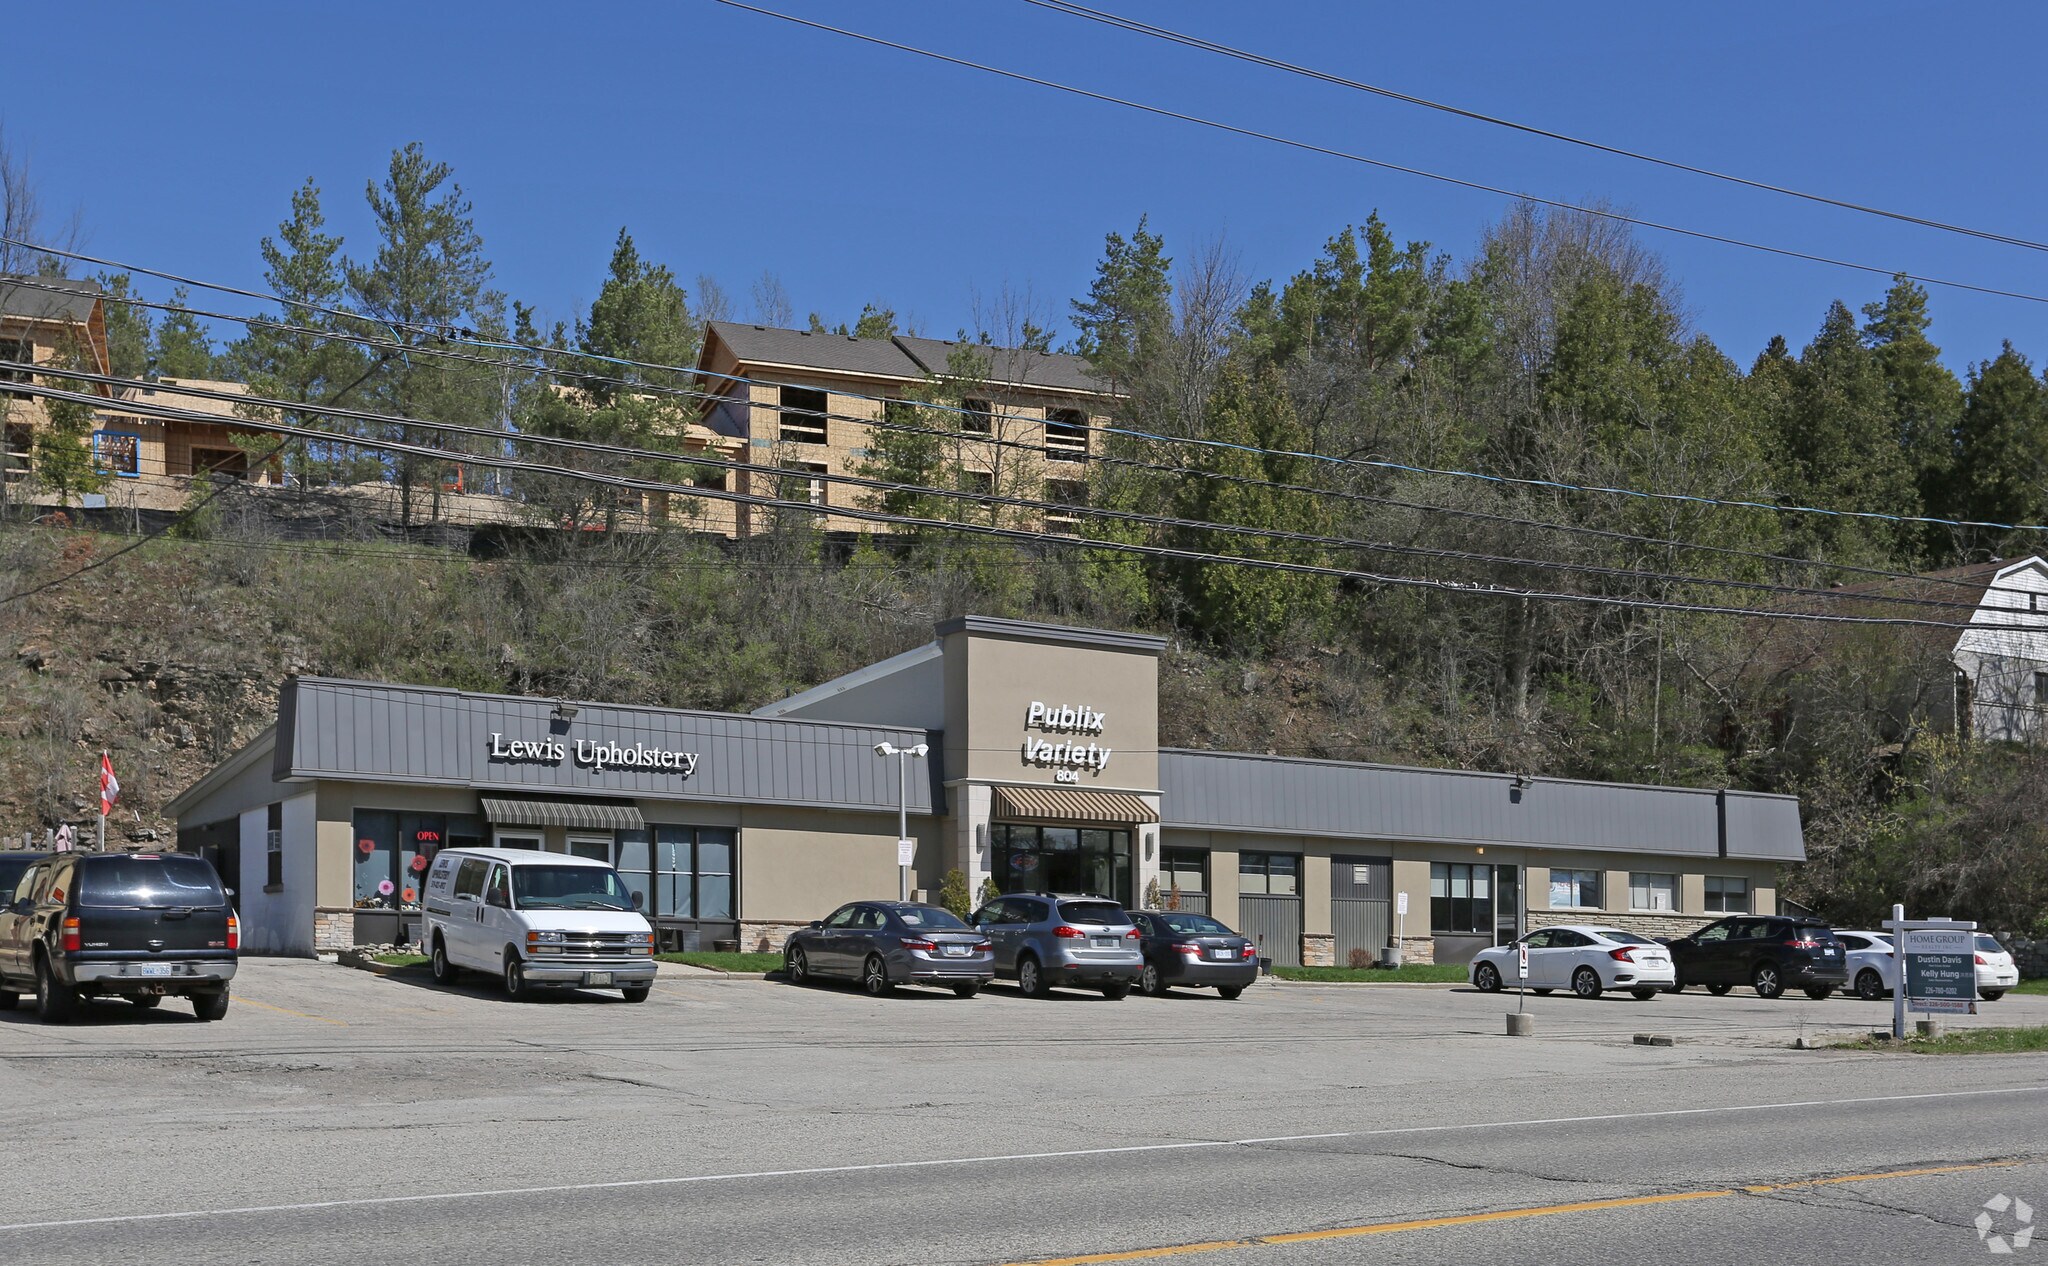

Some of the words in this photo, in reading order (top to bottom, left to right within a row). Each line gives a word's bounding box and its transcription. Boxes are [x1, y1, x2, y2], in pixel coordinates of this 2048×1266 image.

[1028, 701, 1105, 730] Publix
[491, 732, 565, 761] Lewis
[575, 738, 700, 775] Upholstery
[1026, 736, 1112, 770] Variety
[1056, 769, 1080, 782] 804
[416, 832, 439, 840] OPEN
[1917, 955, 1941, 963] Dustin
[1921, 970, 1938, 978] Kelly
[1940, 970, 1960, 979] Hung
